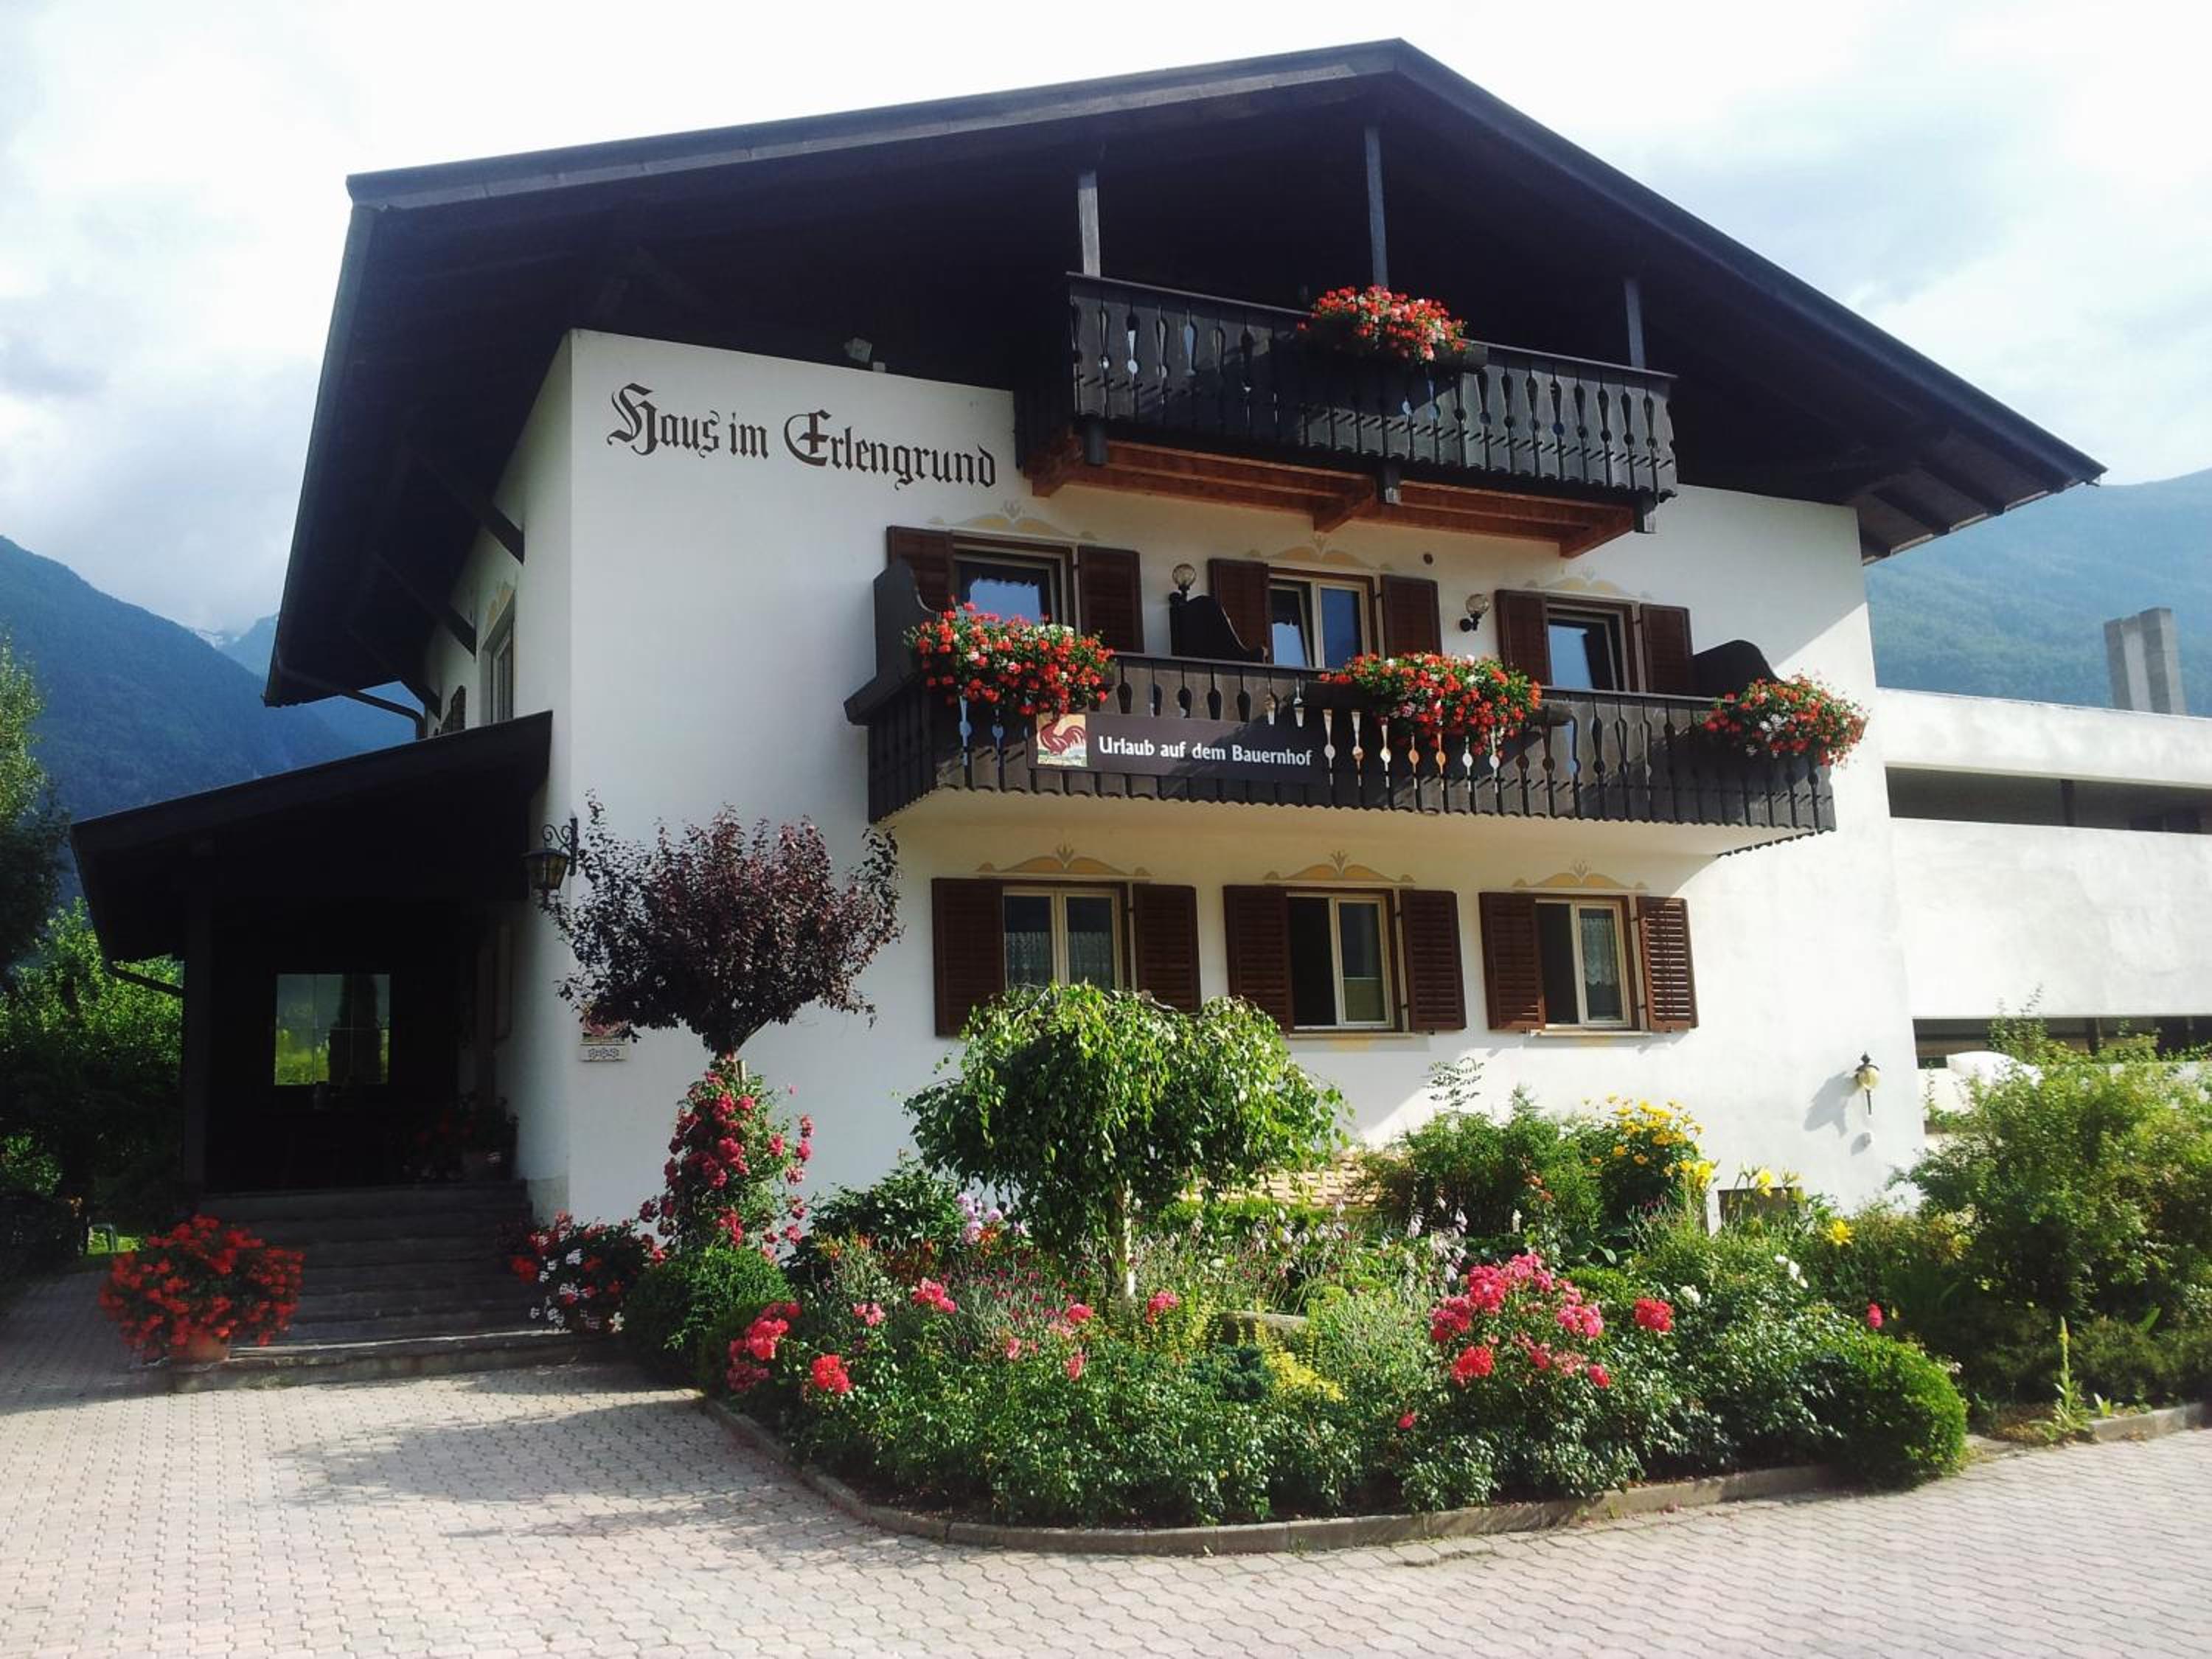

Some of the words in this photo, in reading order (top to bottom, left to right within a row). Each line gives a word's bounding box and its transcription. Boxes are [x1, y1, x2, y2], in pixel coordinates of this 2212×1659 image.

[607, 383, 720, 458] Haus
[729, 412, 769, 459] im
[784, 409, 997, 491] Erlengrund
[1099, 736, 1155, 757] Urlaub
[1160, 740, 1186, 758] auf
[1192, 743, 1226, 761] dem
[1232, 745, 1312, 767] Bauernhof
